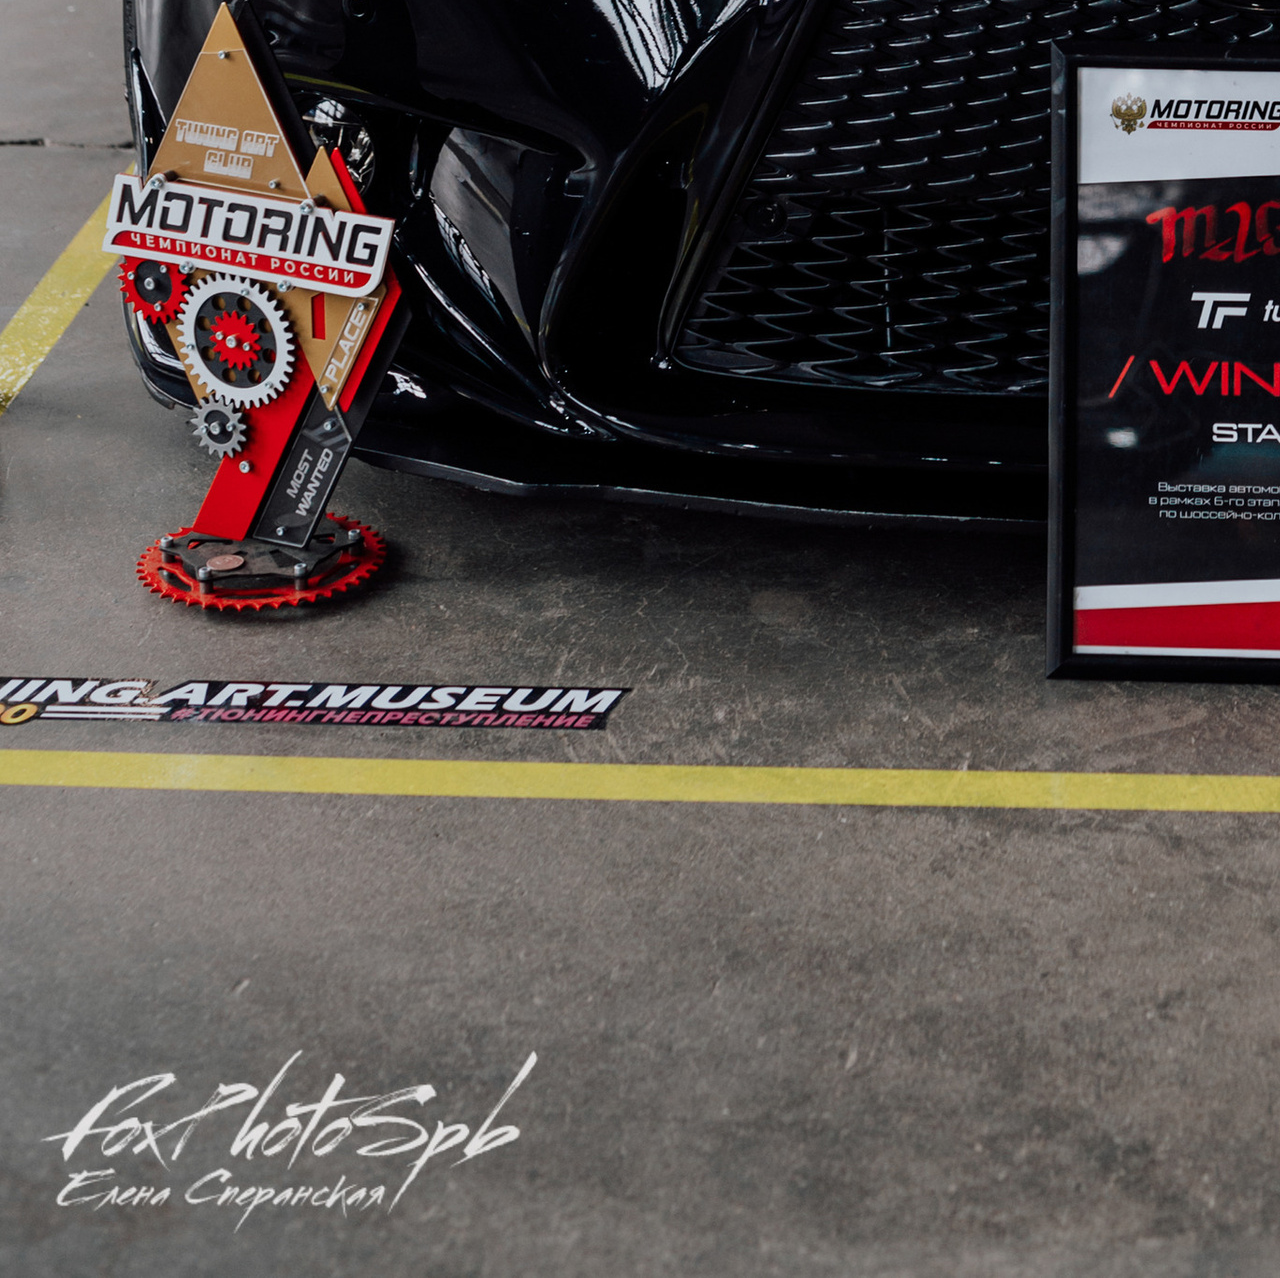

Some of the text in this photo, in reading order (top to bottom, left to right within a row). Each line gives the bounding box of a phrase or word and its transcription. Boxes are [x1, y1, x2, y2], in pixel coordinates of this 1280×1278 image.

[1156, 121, 1223, 129] ЧЕМПИОНАТ
[115, 183, 383, 268] MOTORING
[130, 232, 356, 285] ЧЕМПИОНАТ РОССИИ
[1190, 291, 1252, 329] TF
[325, 308, 368, 383] PLACE
[286, 448, 313, 499] MOST
[295, 447, 334, 517] WANTED
[1158, 482, 1226, 493] Выставка
[1149, 497, 1157, 505] в
[1160, 497, 1211, 507] рамках
[1159, 509, 1177, 518] по
[171, 707, 596, 728] #ТЮНИНГНЕПРЕСТУПЛЕНИЕ
